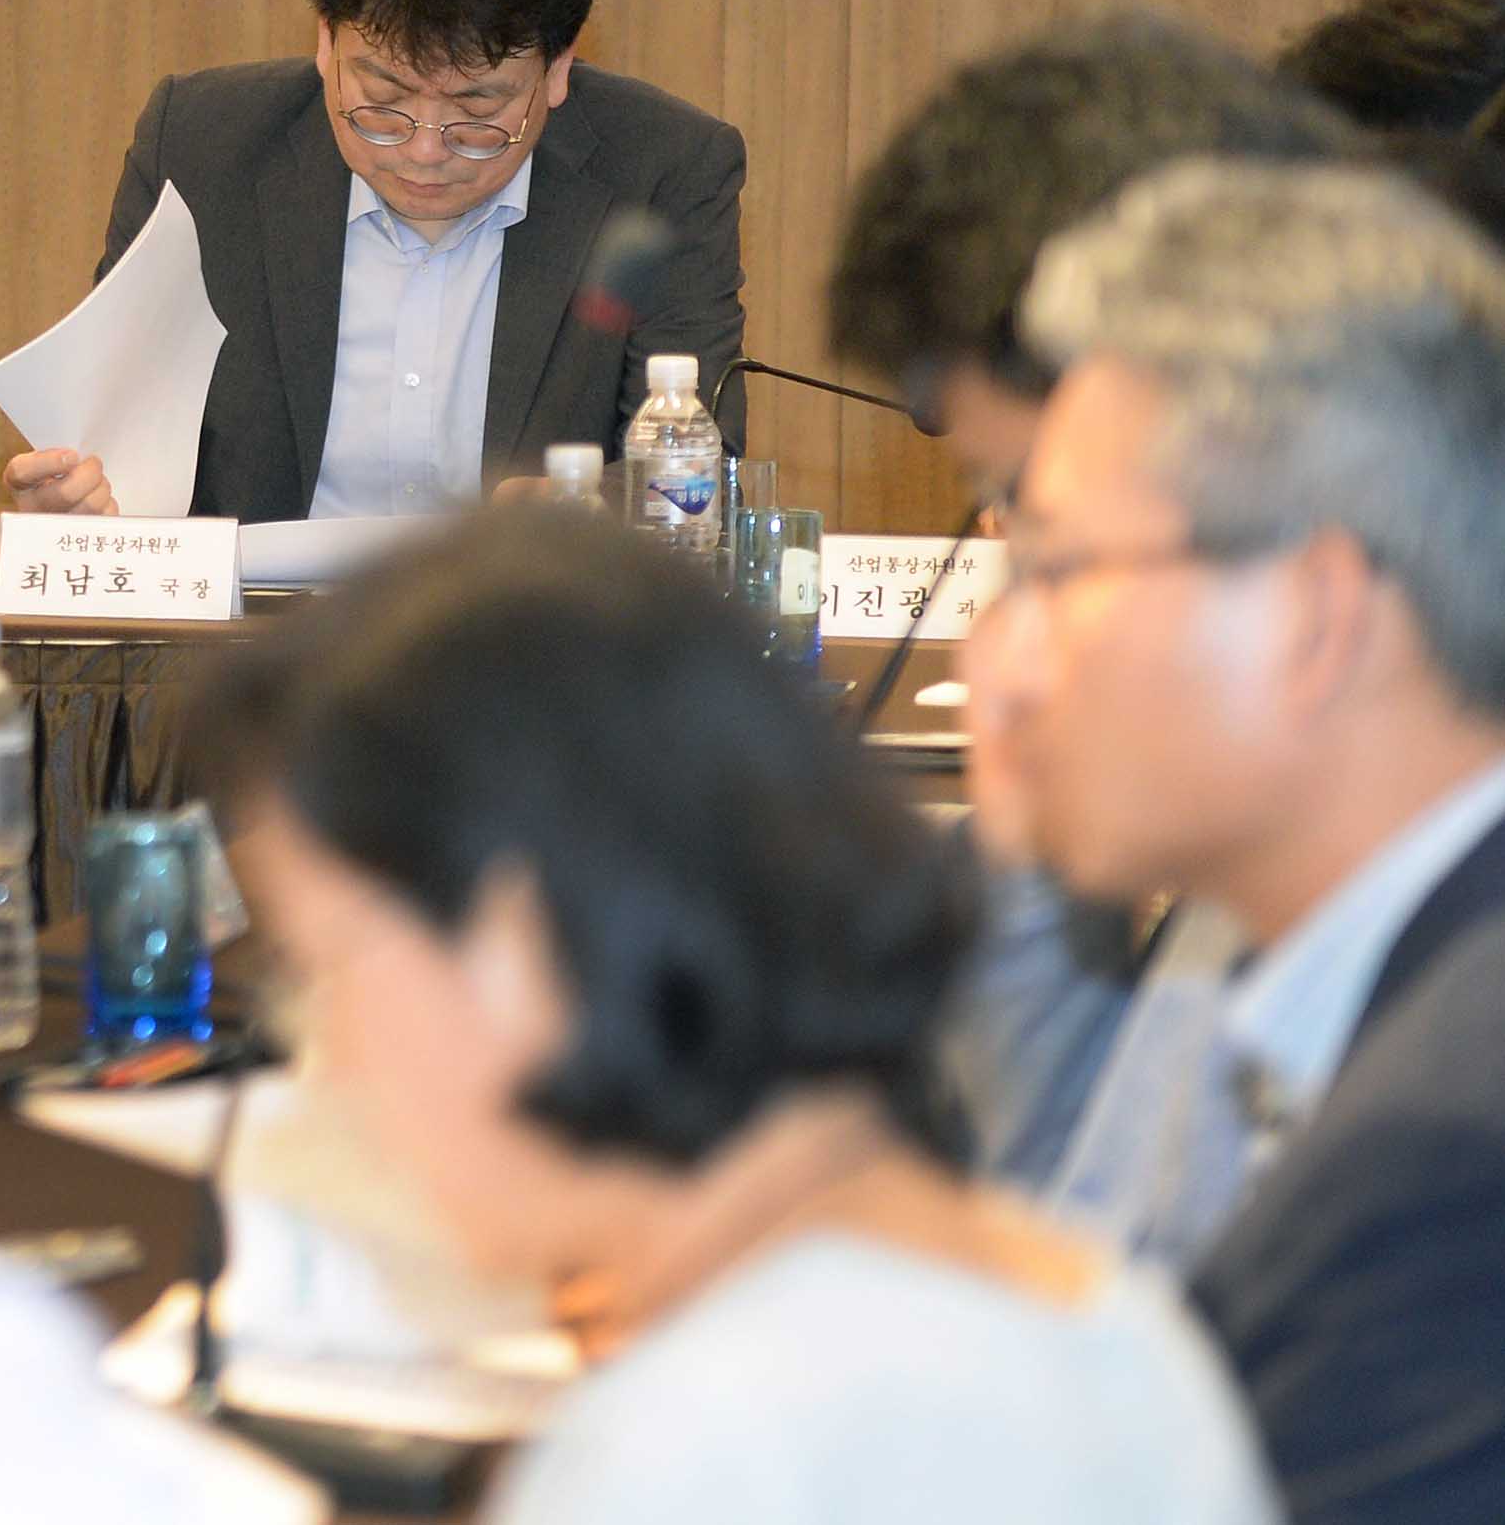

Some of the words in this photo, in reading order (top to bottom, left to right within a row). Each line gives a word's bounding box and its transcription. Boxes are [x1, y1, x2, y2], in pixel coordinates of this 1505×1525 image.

[56, 534, 182, 555] 산업통상자원부
[846, 555, 979, 576] 산업통상자원부
[20, 562, 137, 597] 최남호
